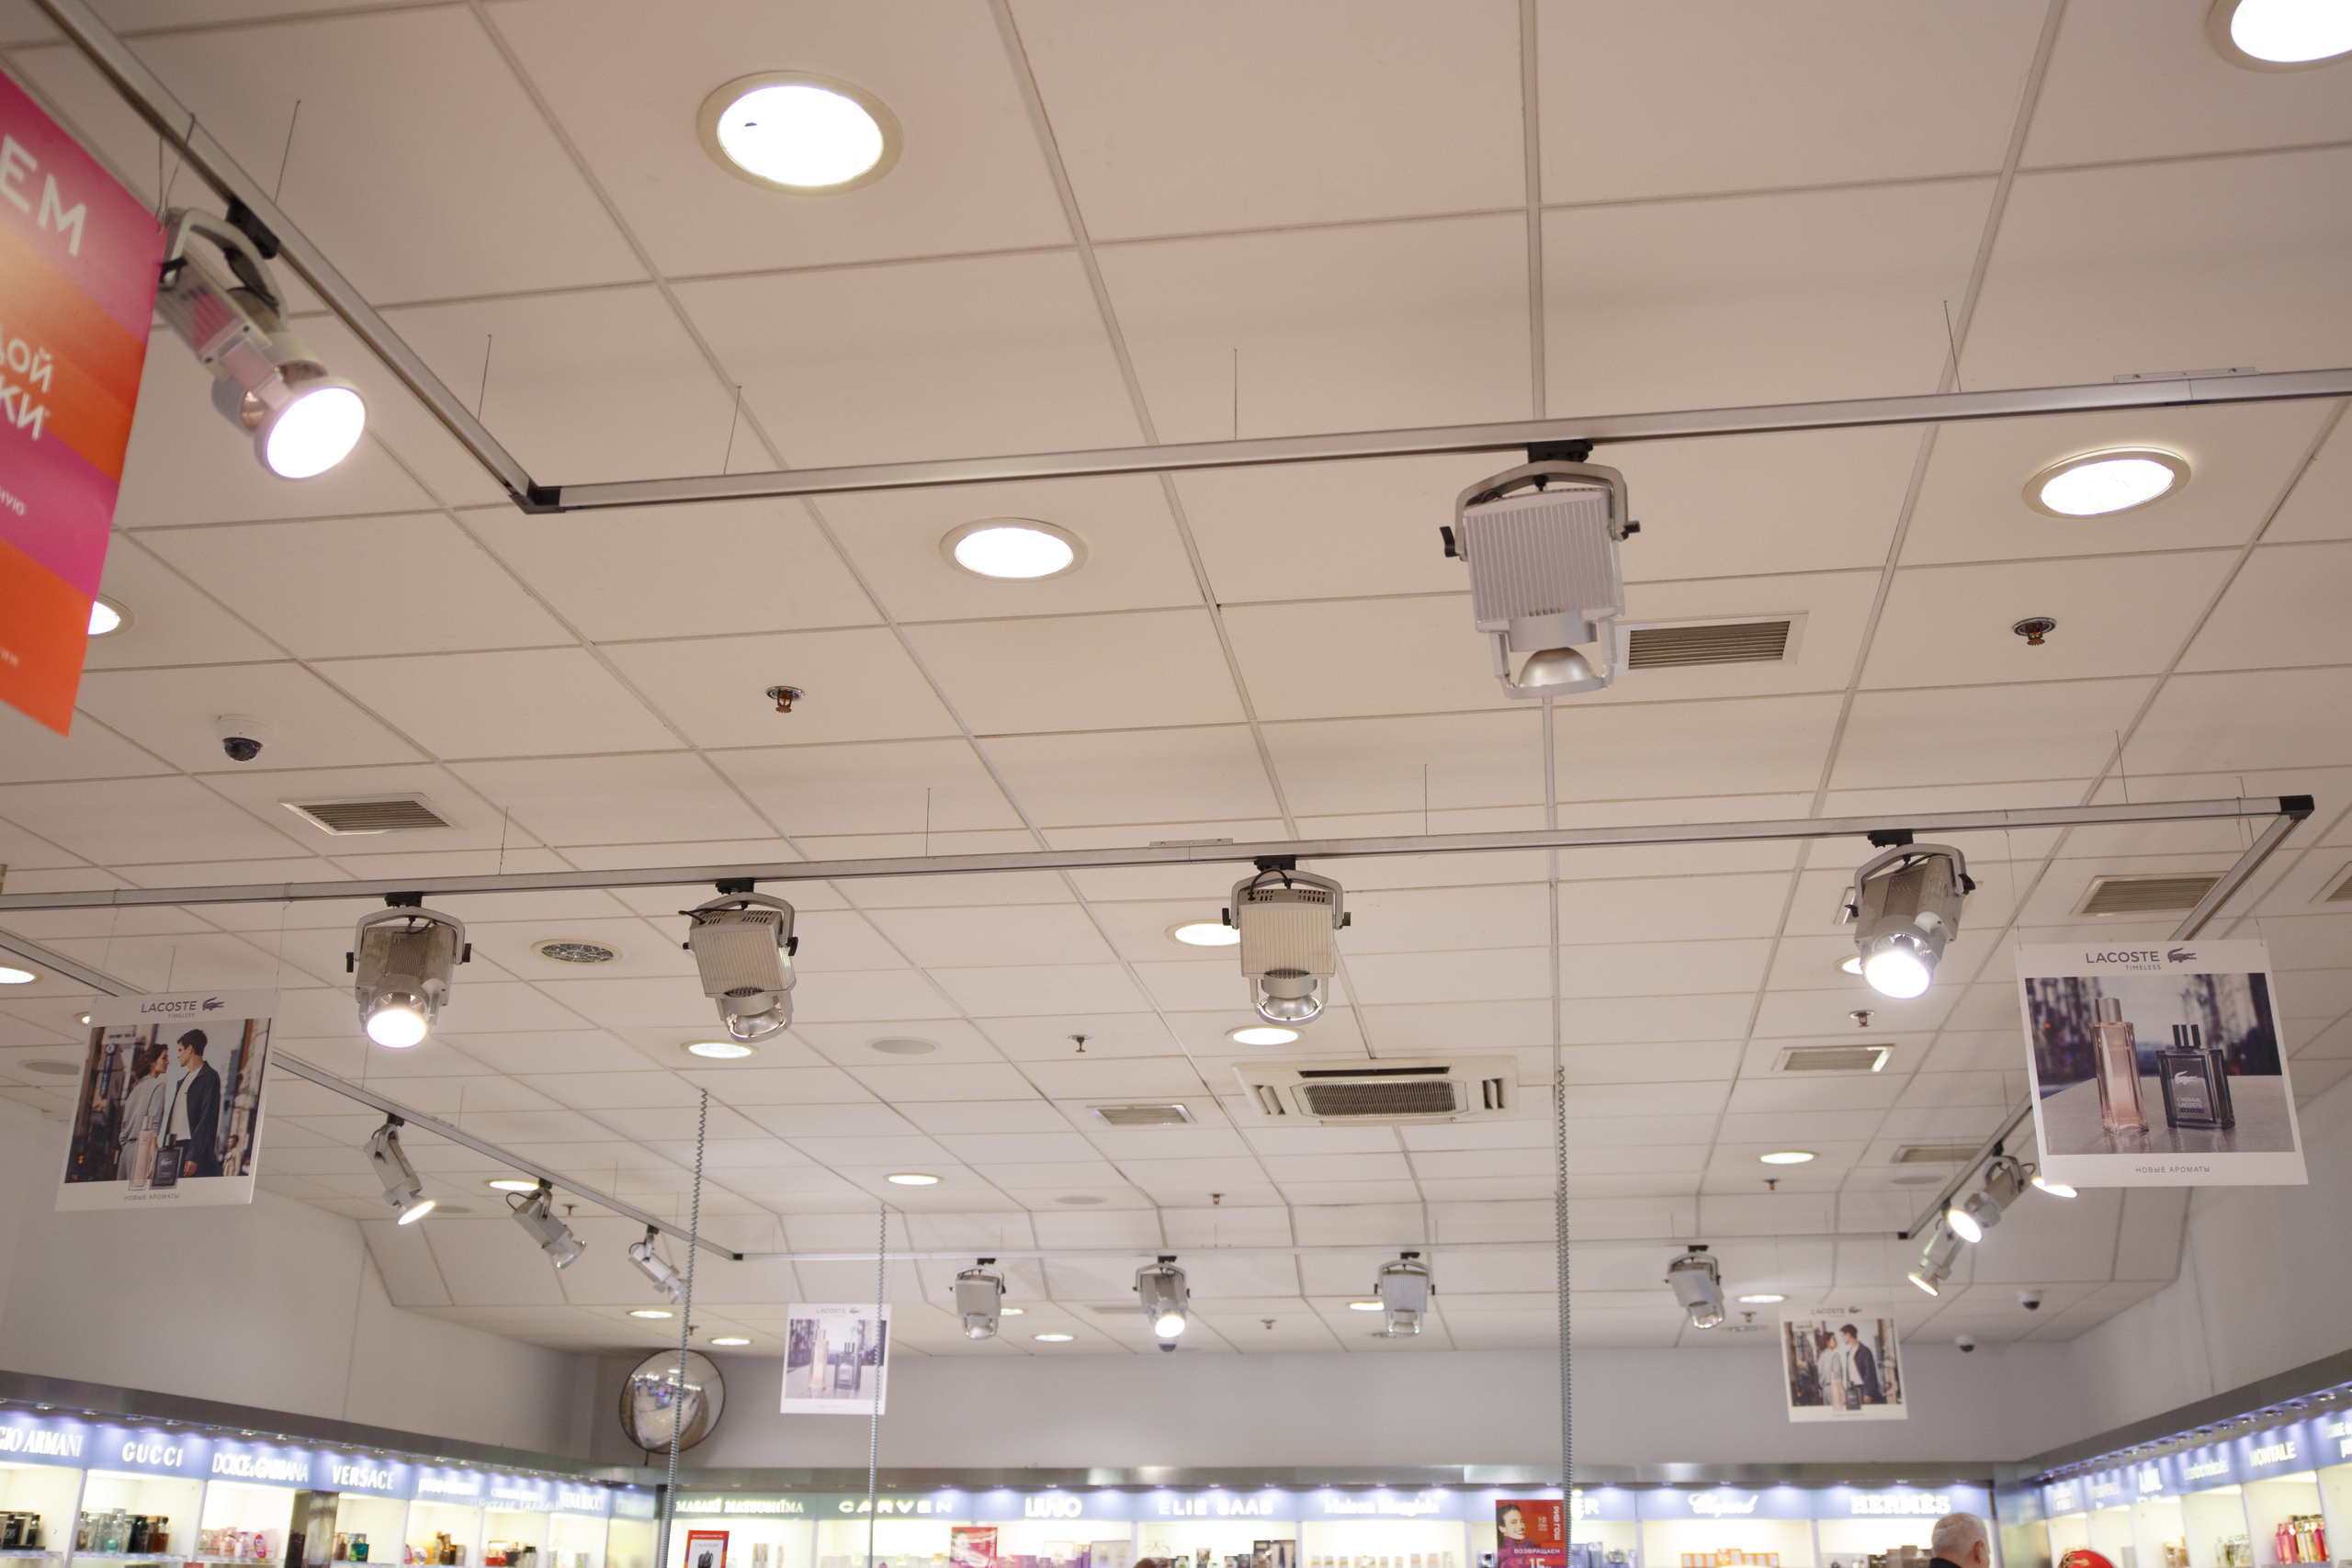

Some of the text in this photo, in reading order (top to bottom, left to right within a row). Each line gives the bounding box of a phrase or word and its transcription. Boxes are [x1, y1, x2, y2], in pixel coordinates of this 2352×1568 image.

[0, 324, 54, 395] ОЙ
[2086, 951, 2160, 964] LACOSTE
[141, 1000, 198, 1013] LACOSTE
[22, 1429, 84, 1457] ARMANI
[121, 1441, 185, 1468] GUCCI
[332, 1464, 395, 1490] VERSACE
[838, 1500, 954, 1514] CARVEN
[1158, 1498, 1273, 1516] ELIE SAAB
